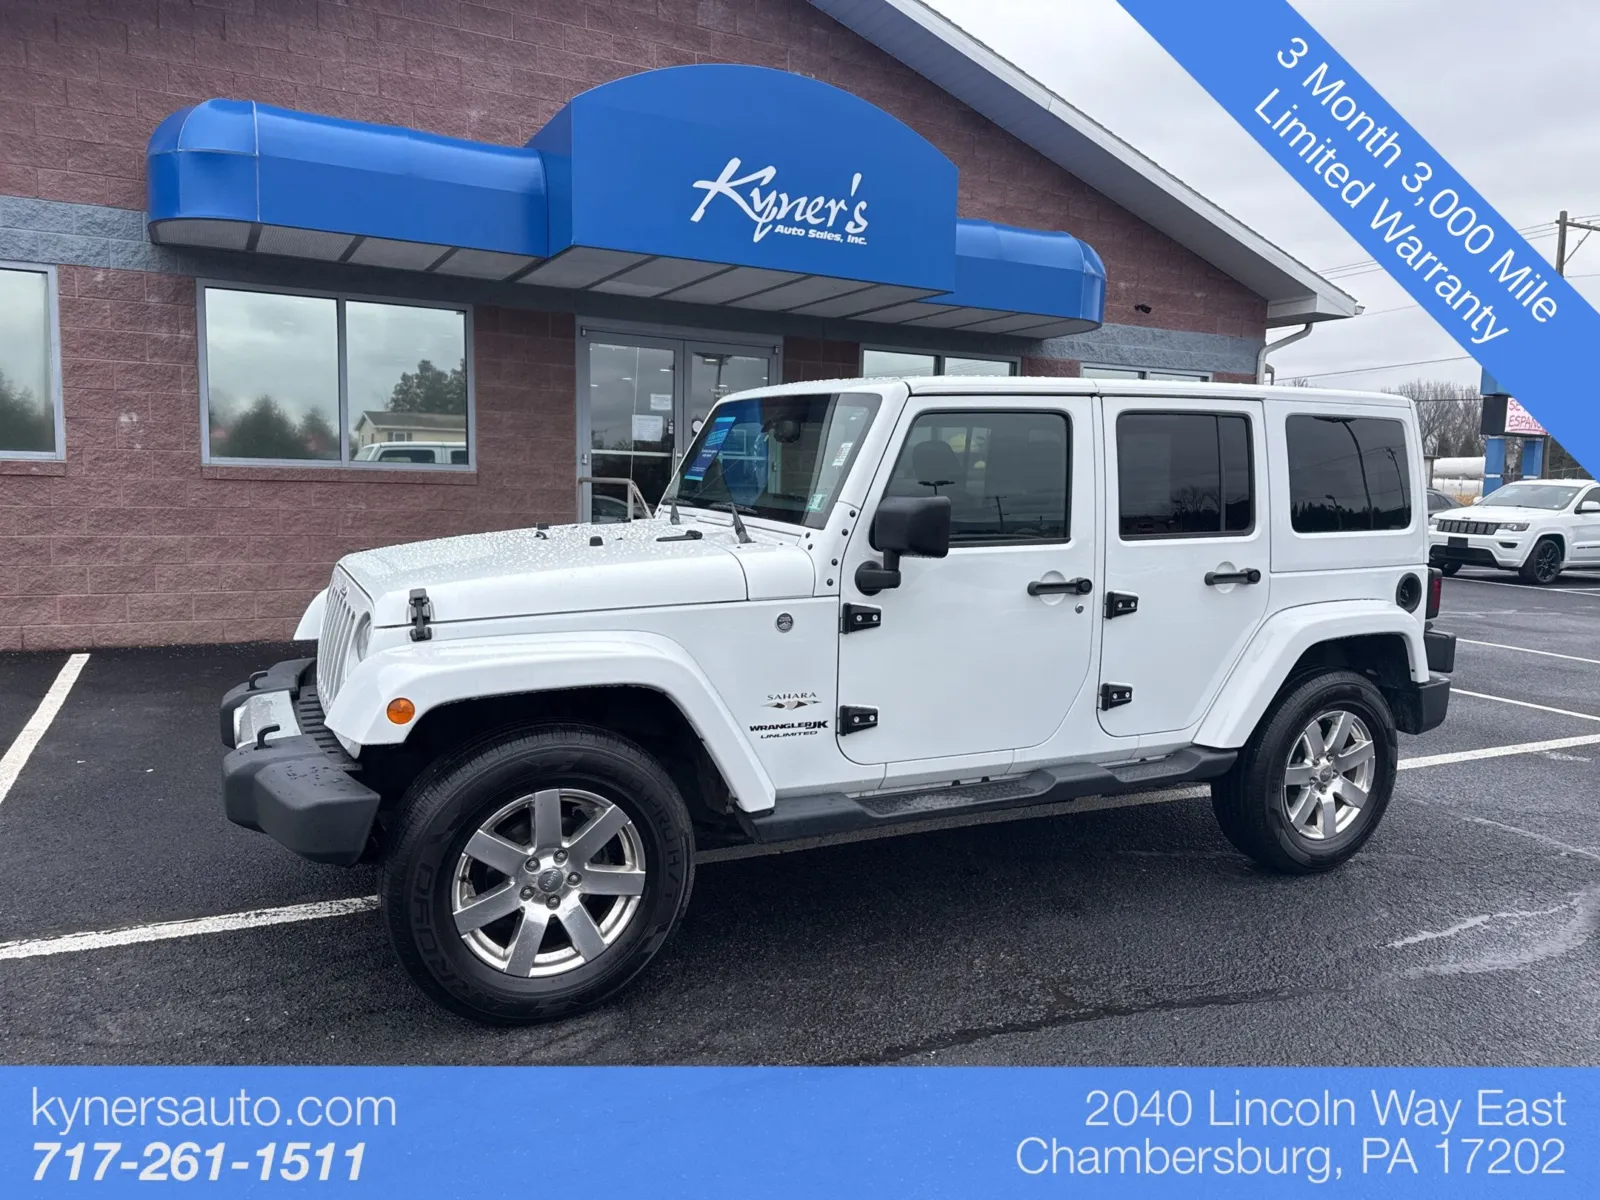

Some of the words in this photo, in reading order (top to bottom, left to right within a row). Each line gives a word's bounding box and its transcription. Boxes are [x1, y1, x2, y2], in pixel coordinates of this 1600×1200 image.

[690, 157, 869, 243] Kyner's
[774, 224, 806, 237] Auto
[808, 229, 843, 243] Sales,
[847, 234, 868, 245] Inc.
[767, 692, 817, 700] SAHARA
[760, 731, 818, 739] UNLIMITED
